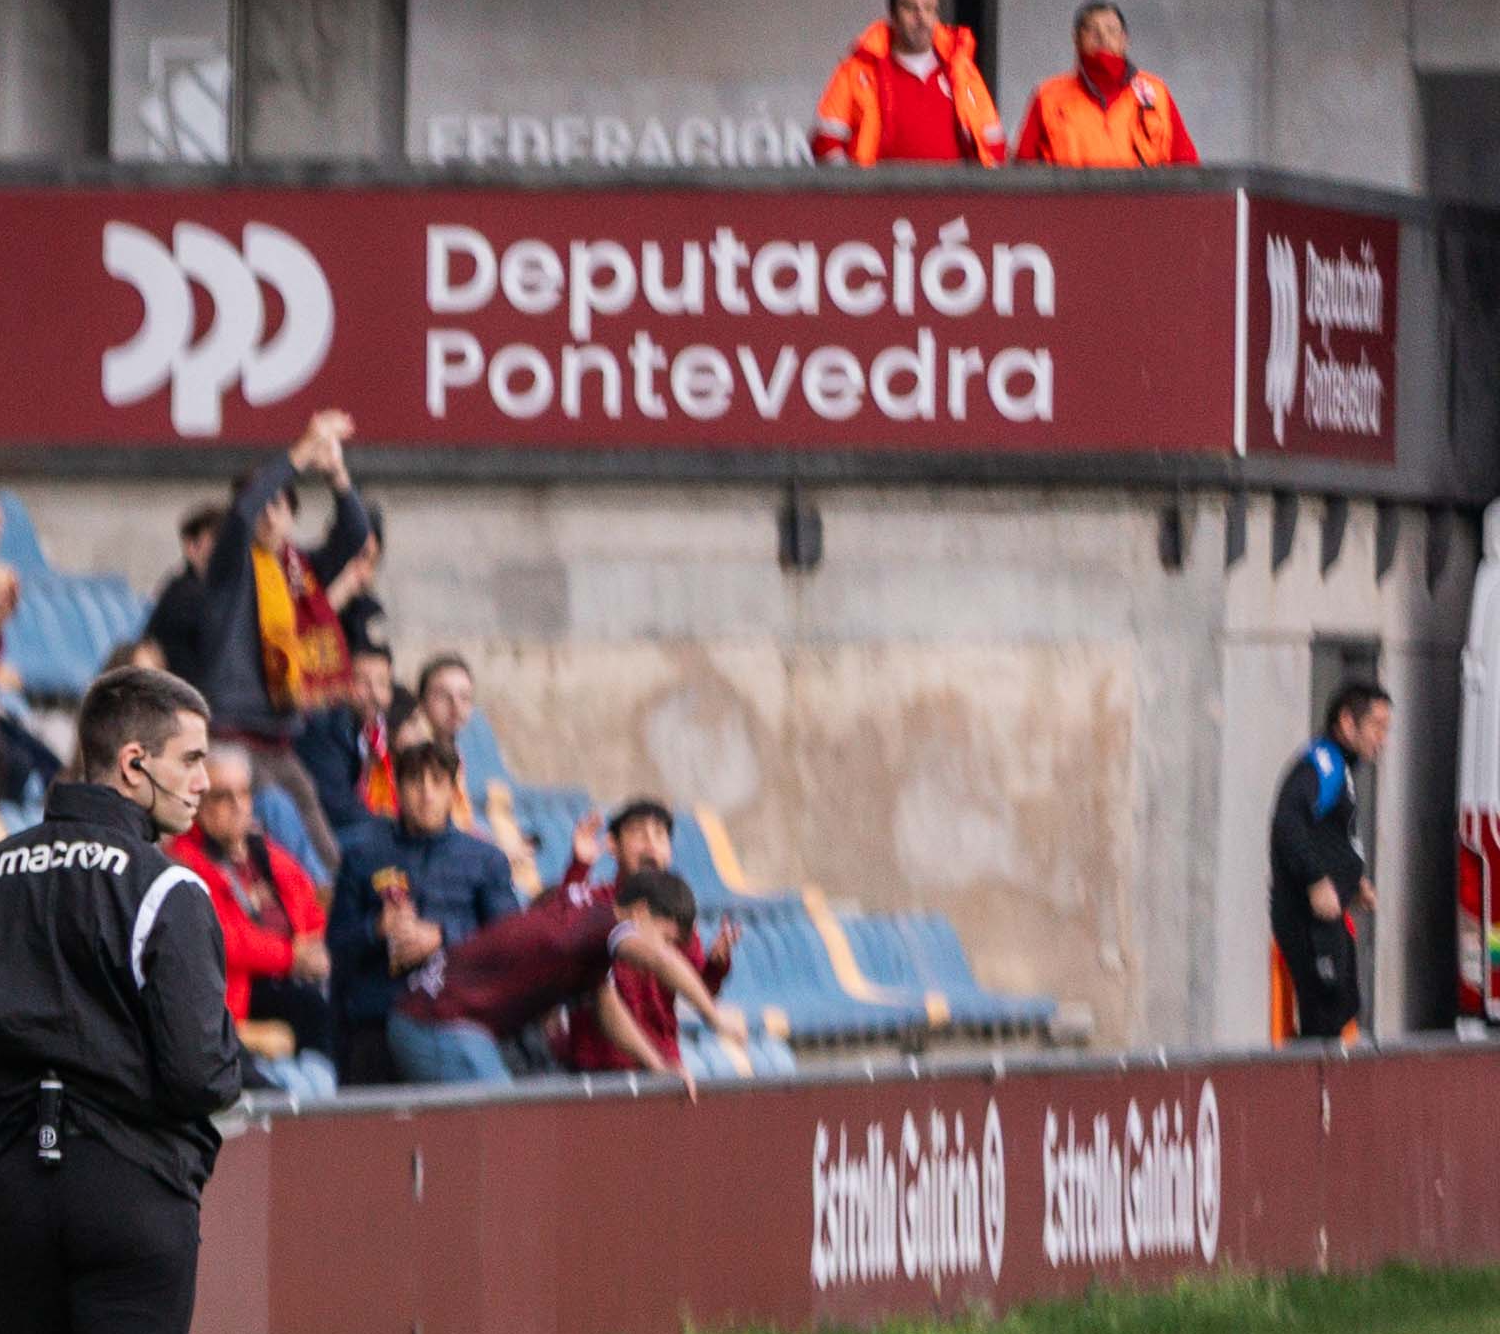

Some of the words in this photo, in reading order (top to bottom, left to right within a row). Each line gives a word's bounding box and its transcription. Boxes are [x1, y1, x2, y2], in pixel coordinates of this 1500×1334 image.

[426, 218, 1056, 340] Deputación
[426, 328, 1054, 420] Pontevedra
[810, 1114, 897, 1290] Estrella
[901, 1105, 980, 1281] Galicia
[1043, 1104, 1123, 1269] Estrella
